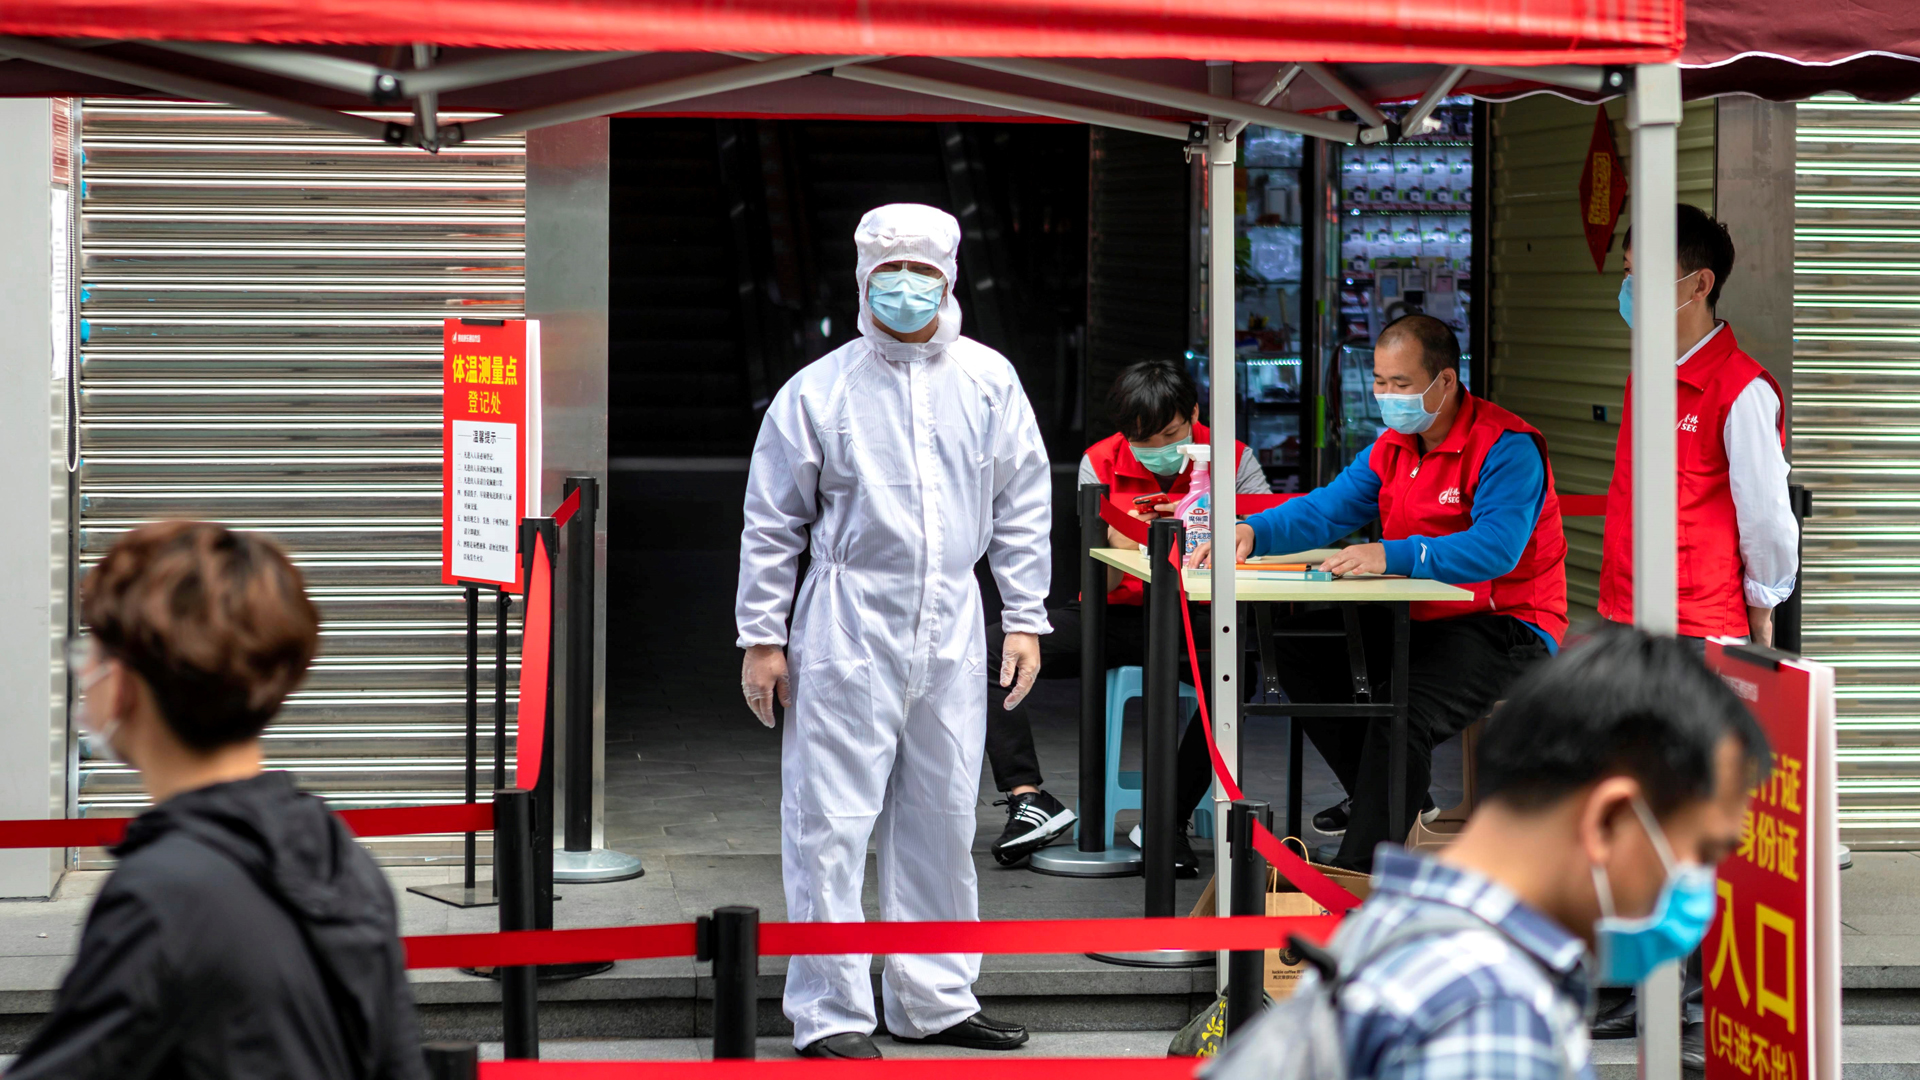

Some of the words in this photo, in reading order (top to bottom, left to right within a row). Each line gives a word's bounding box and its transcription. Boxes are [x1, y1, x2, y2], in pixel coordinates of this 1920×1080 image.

[452, 354, 518, 385] 体温测量点
[468, 390, 501, 414] 登记处
[472, 430, 497, 444] 温馨提示
[1680, 423, 1697, 433] SEG
[1447, 496, 1460, 504] SEG
[1736, 806, 1799, 883] 身份证
[1708, 878, 1797, 1035] 入口
